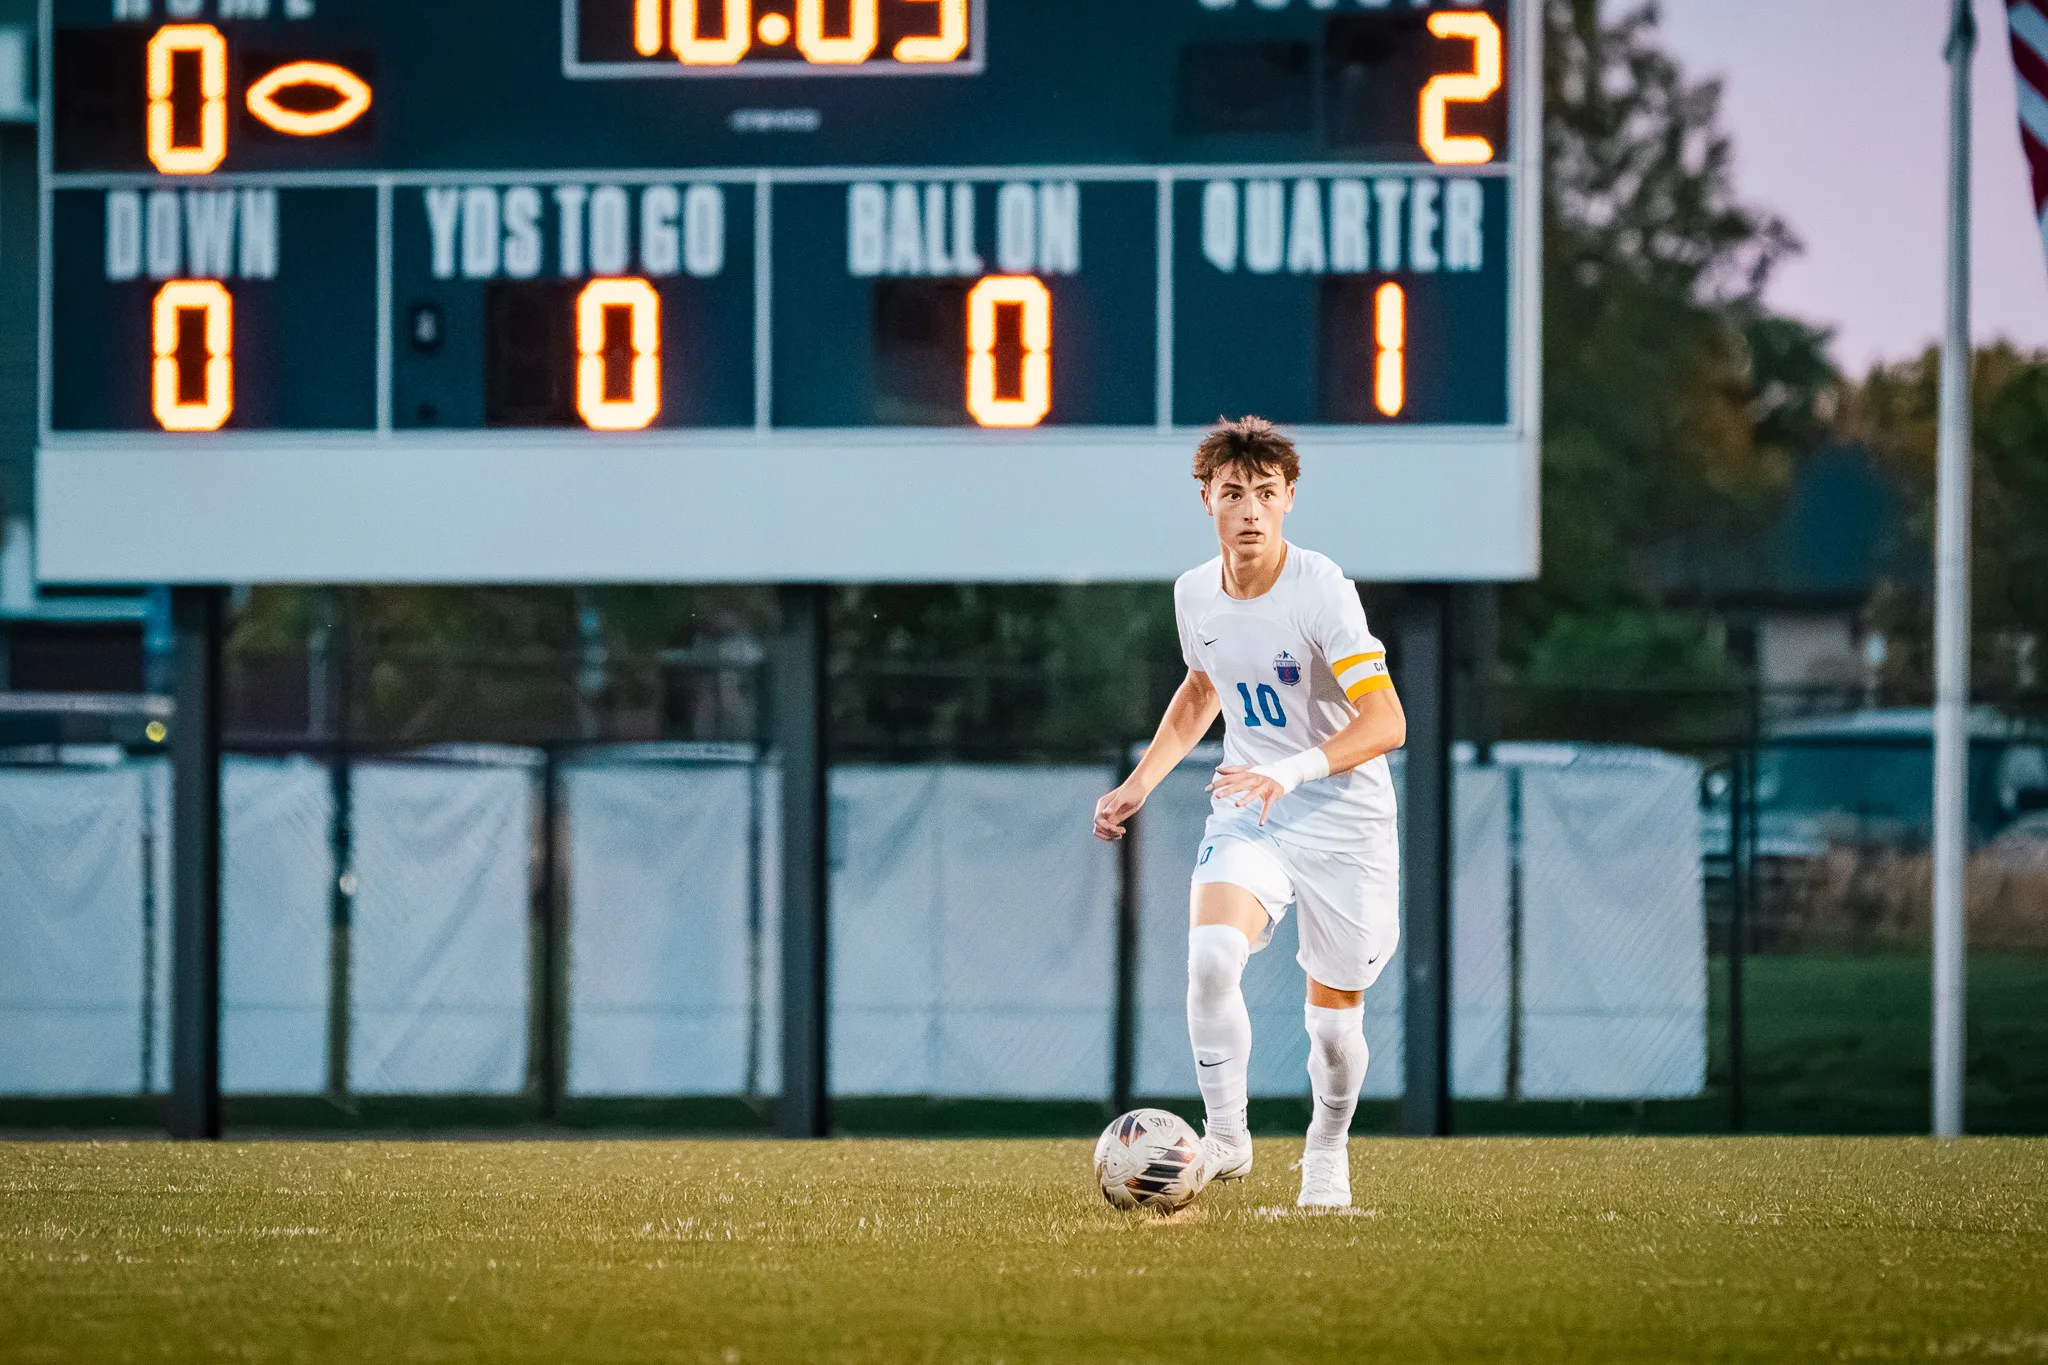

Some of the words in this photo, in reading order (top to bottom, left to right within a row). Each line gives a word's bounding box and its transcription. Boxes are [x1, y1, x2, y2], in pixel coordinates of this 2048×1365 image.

[147, 24, 228, 174] 0
[1418, 11, 1503, 165] 2
[105, 190, 279, 280] DOWN
[424, 185, 543, 279] YDS
[555, 185, 630, 278] TO
[640, 185, 726, 277] GO
[847, 182, 983, 277] BALL
[996, 182, 1082, 276] ON
[1201, 180, 1485, 274] QUARTER
[152, 279, 234, 431] 0
[576, 277, 661, 430] 0
[966, 275, 1052, 428] 0
[1374, 281, 1406, 417] 1
[1236, 682, 1286, 727] 10
